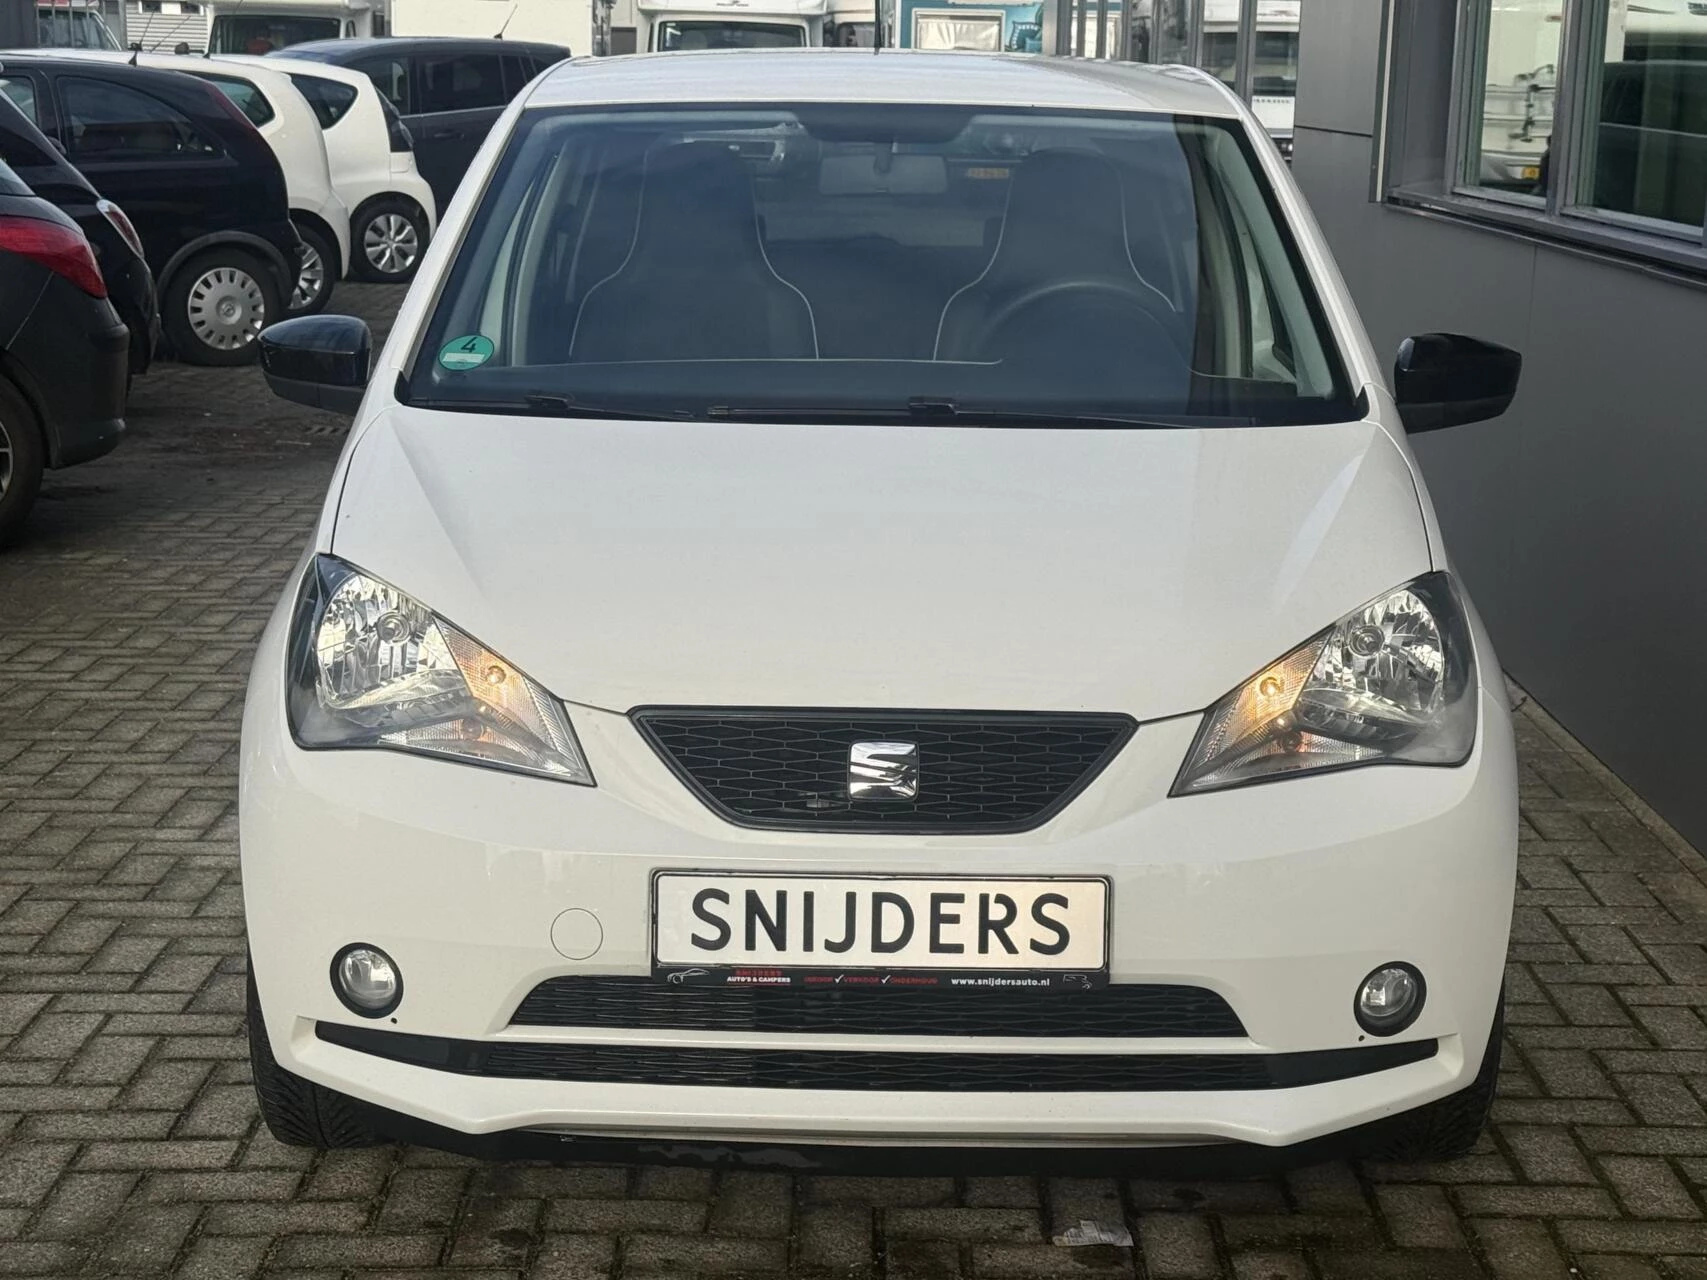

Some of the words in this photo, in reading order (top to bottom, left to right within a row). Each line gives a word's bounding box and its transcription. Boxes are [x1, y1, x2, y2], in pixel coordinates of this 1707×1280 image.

[460, 336, 478, 353] 4
[690, 887, 1071, 955] SNIJDERS
[951, 977, 1050, 987] www.snijdersauto.nl
